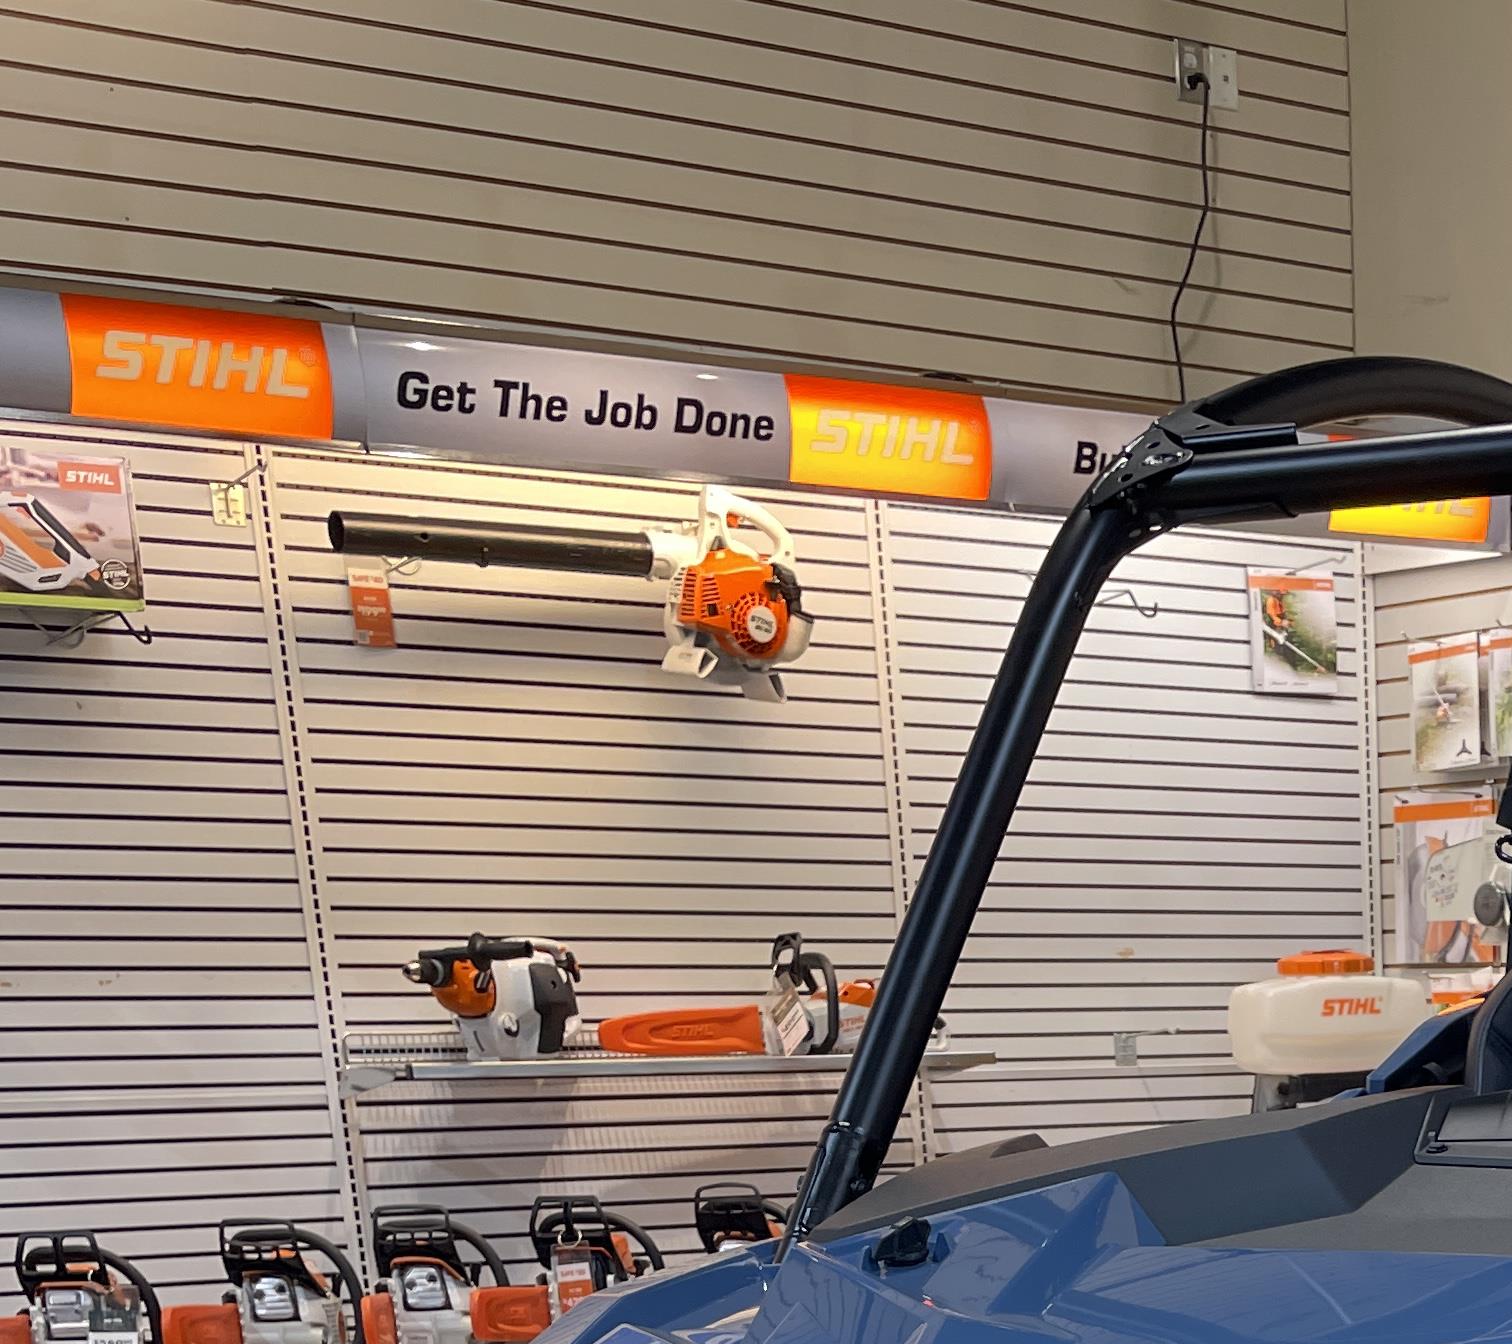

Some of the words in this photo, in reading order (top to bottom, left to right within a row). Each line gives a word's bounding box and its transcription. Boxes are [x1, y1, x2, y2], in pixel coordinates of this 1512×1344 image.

[96, 330, 308, 399] STIHL
[397, 371, 476, 414] Get
[493, 379, 568, 422] The
[584, 389, 657, 431] Job
[673, 397, 775, 441] Done
[811, 408, 974, 466] STIHL
[65, 470, 114, 486] STIHL
[1321, 997, 1381, 1017] STIHL
